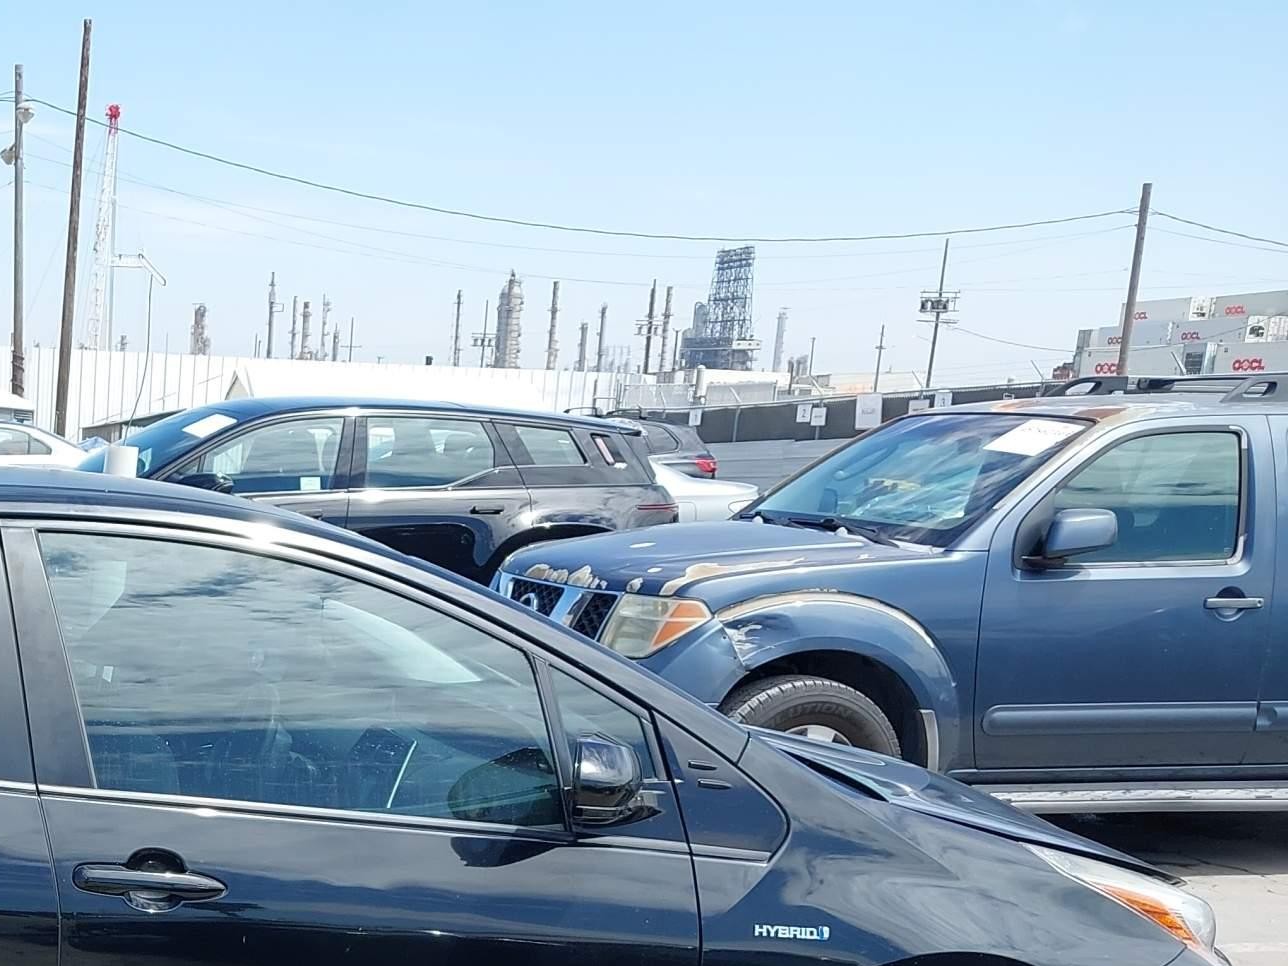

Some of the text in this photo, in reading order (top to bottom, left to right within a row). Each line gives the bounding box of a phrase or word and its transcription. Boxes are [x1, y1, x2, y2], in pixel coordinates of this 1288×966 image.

[1134, 311, 1148, 320] OCL
[1224, 305, 1246, 316] OOCL
[1107, 336, 1122, 345] OOC
[1180, 331, 1201, 341] OOCL
[1095, 363, 1120, 375] OOC
[1232, 358, 1265, 371] OOCL
[754, 924, 818, 940] HYBRID
